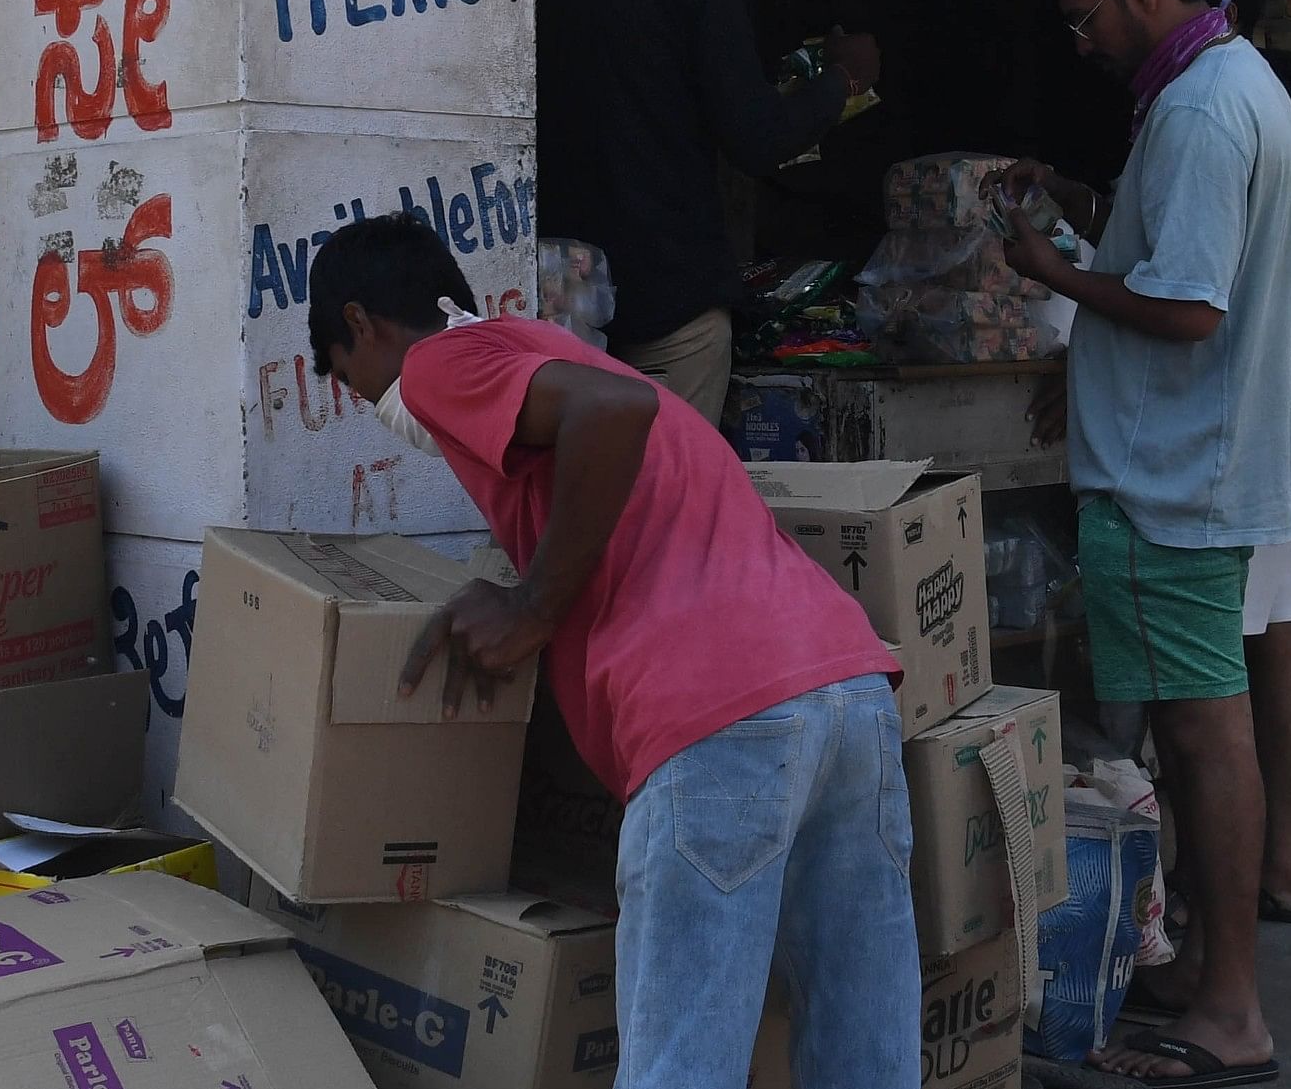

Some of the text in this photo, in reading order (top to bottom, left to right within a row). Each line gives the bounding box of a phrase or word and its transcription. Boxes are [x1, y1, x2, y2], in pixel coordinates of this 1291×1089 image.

[746, 422, 780, 432] NOODLES
[918, 561, 953, 609] Happy
[921, 573, 963, 632] Happy
[923, 974, 992, 1043] arie
[123, 1023, 143, 1057] PARLE
